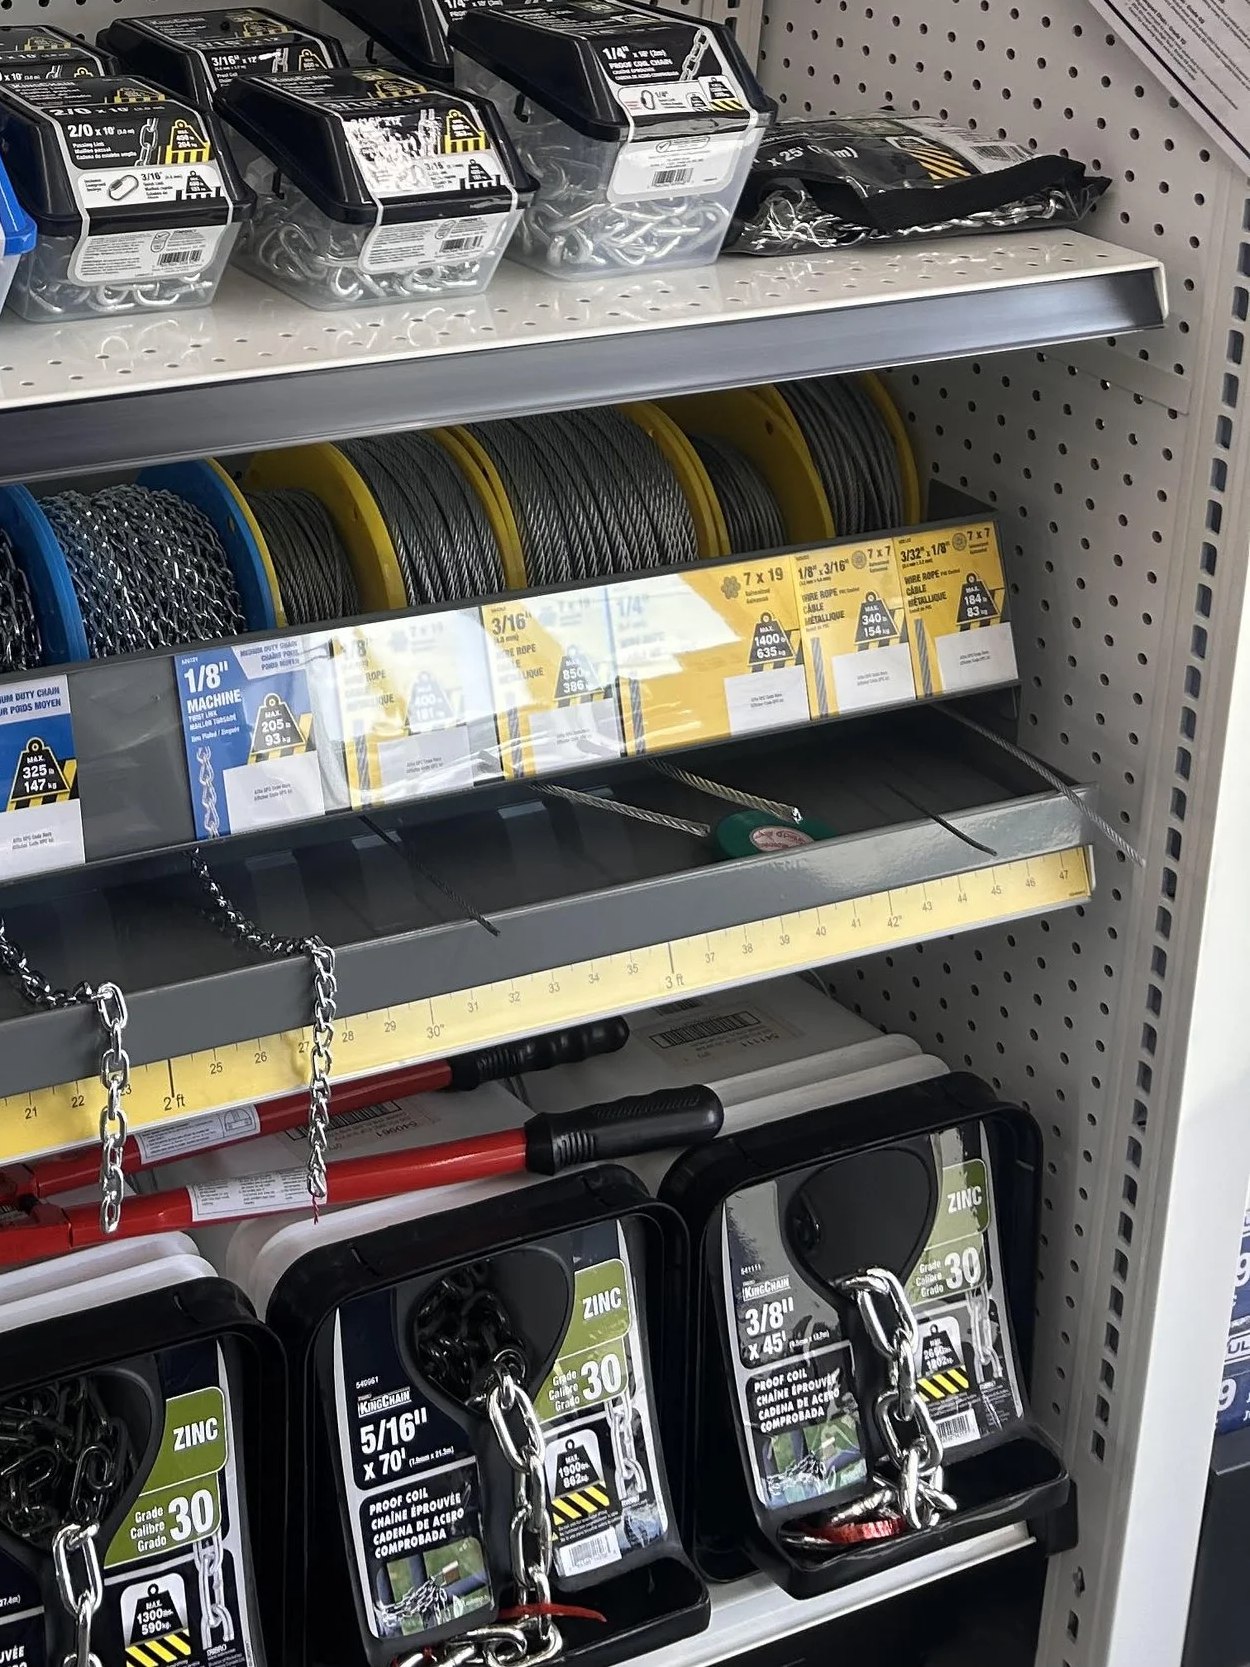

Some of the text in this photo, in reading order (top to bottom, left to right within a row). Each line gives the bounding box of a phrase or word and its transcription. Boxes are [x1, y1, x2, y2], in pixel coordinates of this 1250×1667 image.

[602, 44, 630, 61] 1/4"
[67, 124, 93, 138] 2/0
[768, 567, 784, 582] 19
[963, 593, 981, 605] 184
[861, 613, 881, 625] 340
[966, 605, 979, 617] 83
[753, 634, 780, 646] 1400
[864, 625, 881, 637] 154
[756, 646, 777, 659] 635
[184, 661, 229, 693] 1/8"
[15, 690, 35, 702] DUTY
[37, 686, 61, 700] CHAIN
[186, 688, 241, 713] MACHINE
[261, 718, 284, 732] 205
[265, 732, 281, 746] 93
[22, 764, 48, 779] 325
[24, 779, 47, 794] 147
[174, 1093, 186, 1108] ft
[946, 1185, 983, 1214] ZINC
[944, 1246, 981, 1288] 30
[581, 1287, 622, 1322] ZINC
[744, 1296, 794, 1337] 3/8"
[762, 1331, 788, 1356] 45'
[580, 1353, 621, 1401] 30
[172, 1417, 219, 1453] ZINC
[359, 1407, 427, 1455] 5/16"
[379, 1448, 406, 1473] 70'
[168, 1488, 216, 1544] 30
[130, 1520, 166, 1540] Calibre
[372, 1508, 465, 1547] CADENA DE ACERO
[374, 1528, 447, 1560] COMPROBADA
